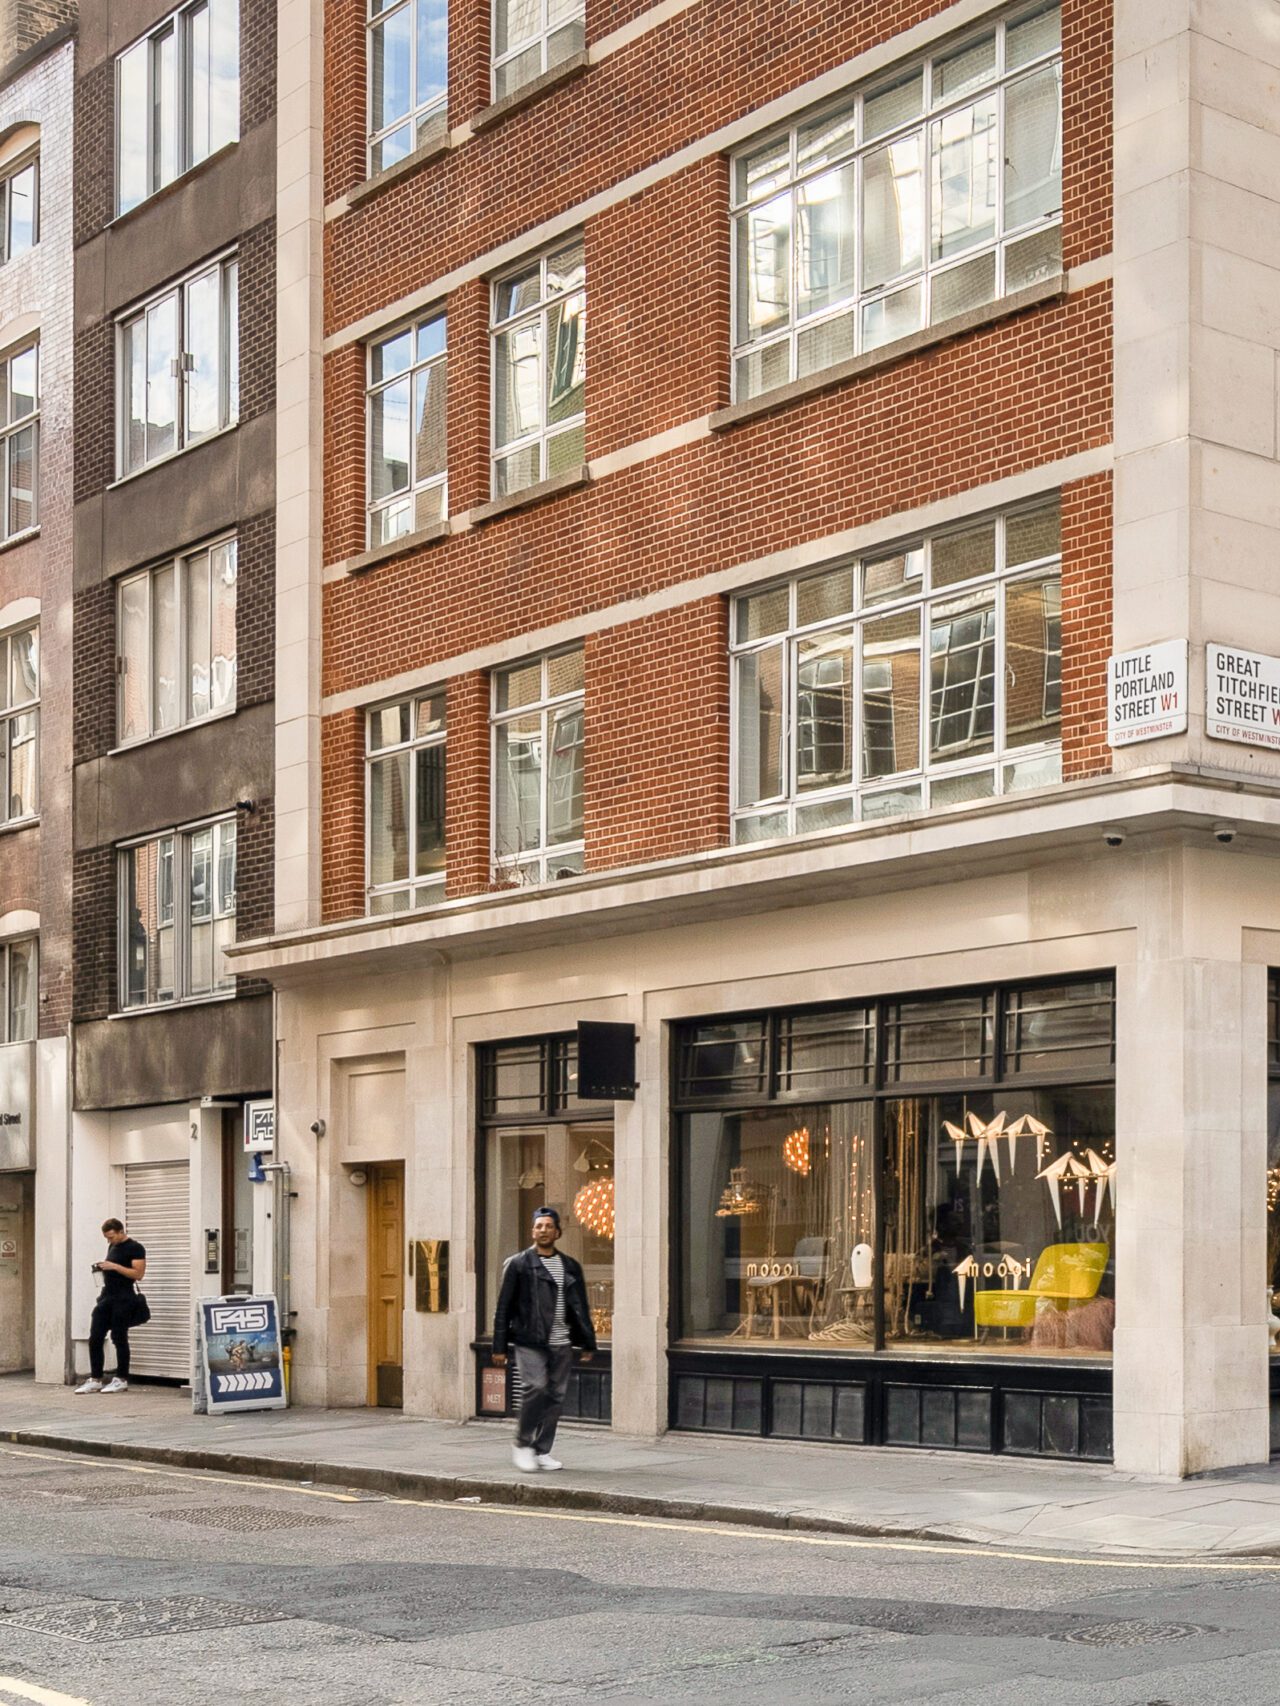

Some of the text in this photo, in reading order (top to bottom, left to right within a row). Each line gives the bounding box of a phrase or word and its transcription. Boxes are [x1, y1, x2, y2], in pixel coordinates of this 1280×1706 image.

[1115, 655, 1151, 679] LITTLE
[1217, 653, 1261, 678] GREAT
[1115, 671, 1174, 700] PORTLAND
[1115, 692, 1178, 722] STREET W1
[1217, 697, 1267, 722] STREET
[1115, 722, 1173, 741] CITY OF WESTMINSTER
[1216, 724, 1230, 736] CITY
[1232, 727, 1240, 737] OF
[191, 1123, 198, 1140] 2
[747, 1262, 799, 1277] moooi
[967, 1258, 1031, 1278] moooi
[211, 1305, 268, 1334] F45
